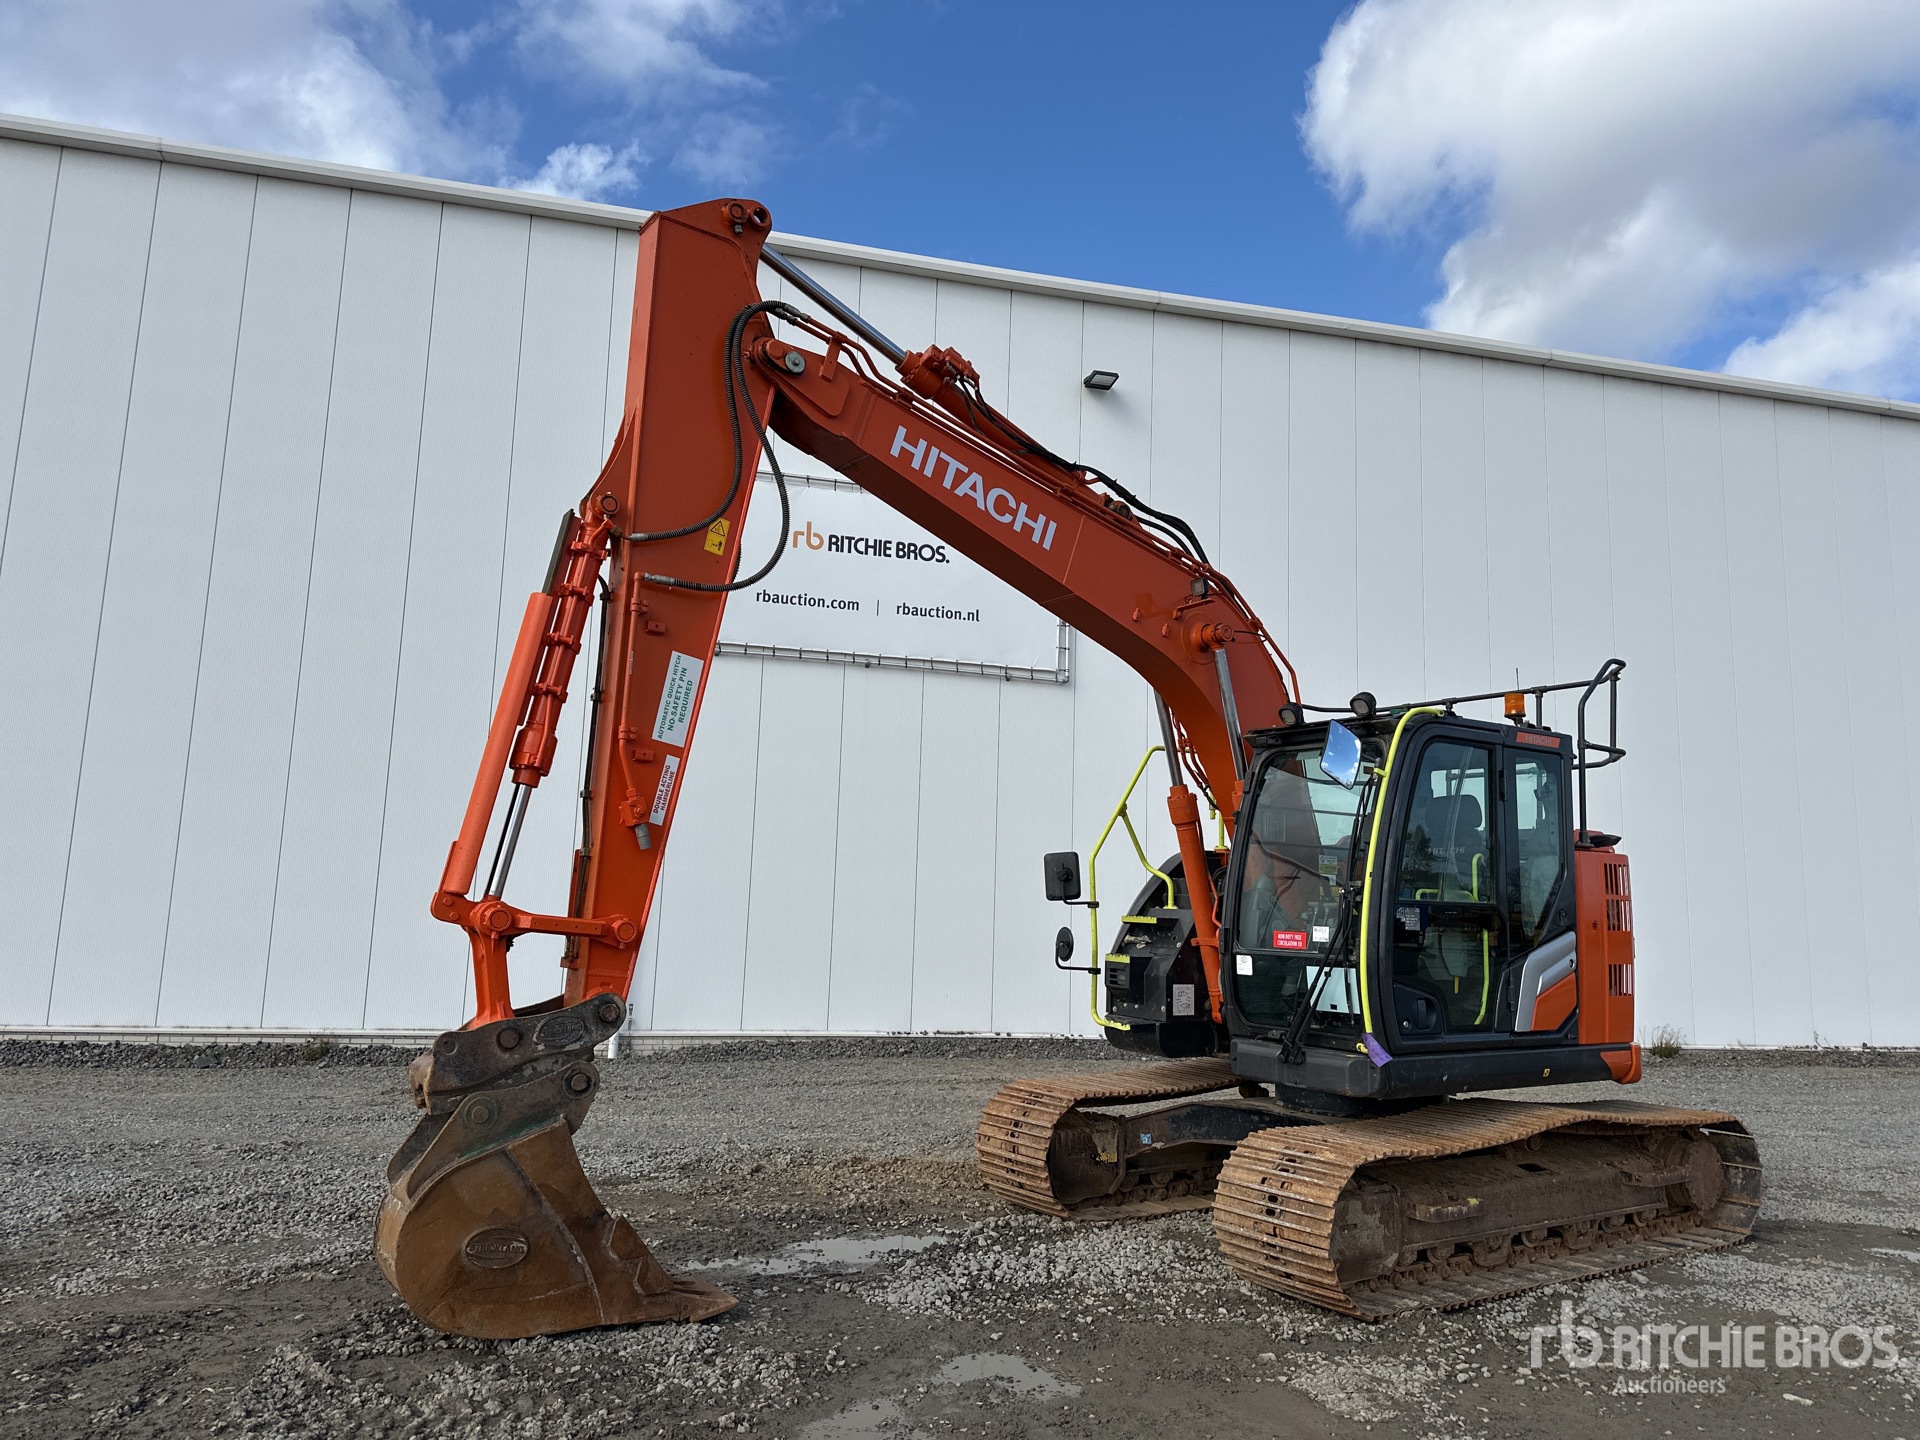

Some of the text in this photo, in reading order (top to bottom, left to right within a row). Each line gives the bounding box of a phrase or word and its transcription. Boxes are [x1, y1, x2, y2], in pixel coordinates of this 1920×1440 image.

[890, 425, 1057, 551] HITACHI
[792, 521, 950, 564] rb RITCHIE BROS.
[756, 589, 980, 622] rbauction.com rbauction.nl
[679, 667, 688, 683] PIN
[657, 654, 682, 740] AUTOMATIC QUICK HITCH
[678, 680, 693, 723] REQUIRED
[653, 765, 671, 814] DOUBLE ACTING
[1428, 846, 1465, 855] HITCHI
